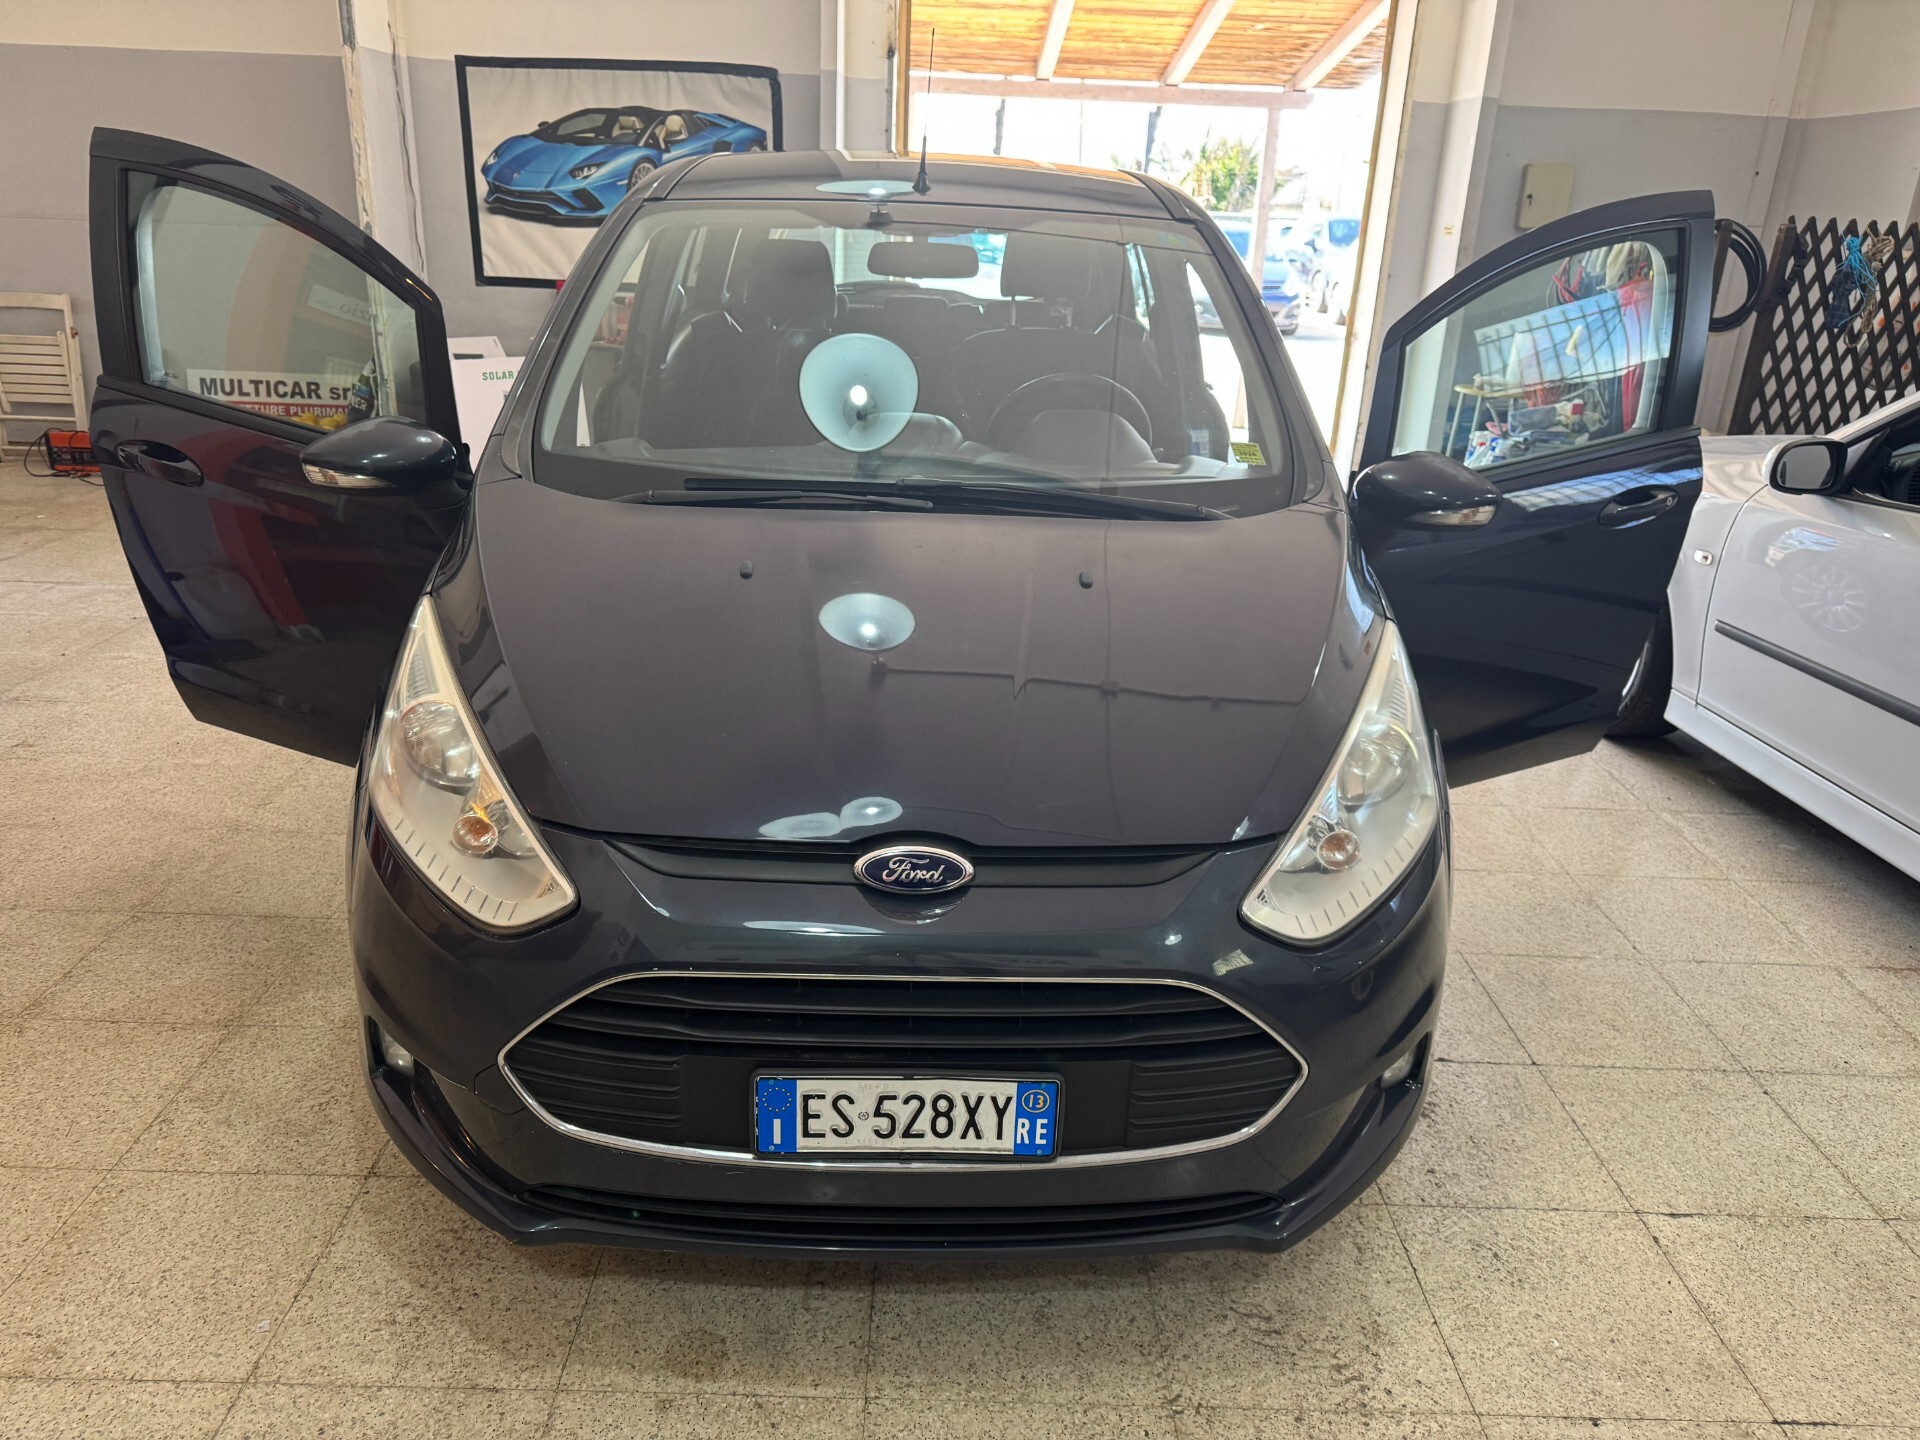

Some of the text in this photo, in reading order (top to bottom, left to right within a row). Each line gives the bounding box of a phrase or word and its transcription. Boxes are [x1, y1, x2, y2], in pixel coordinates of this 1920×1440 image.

[482, 371, 515, 381] SOLAR
[199, 377, 322, 400] MULTICAR
[882, 857, 945, 883] Ford
[1029, 1094, 1044, 1108] 13
[773, 1094, 1048, 1145] I ES 528XY RE
